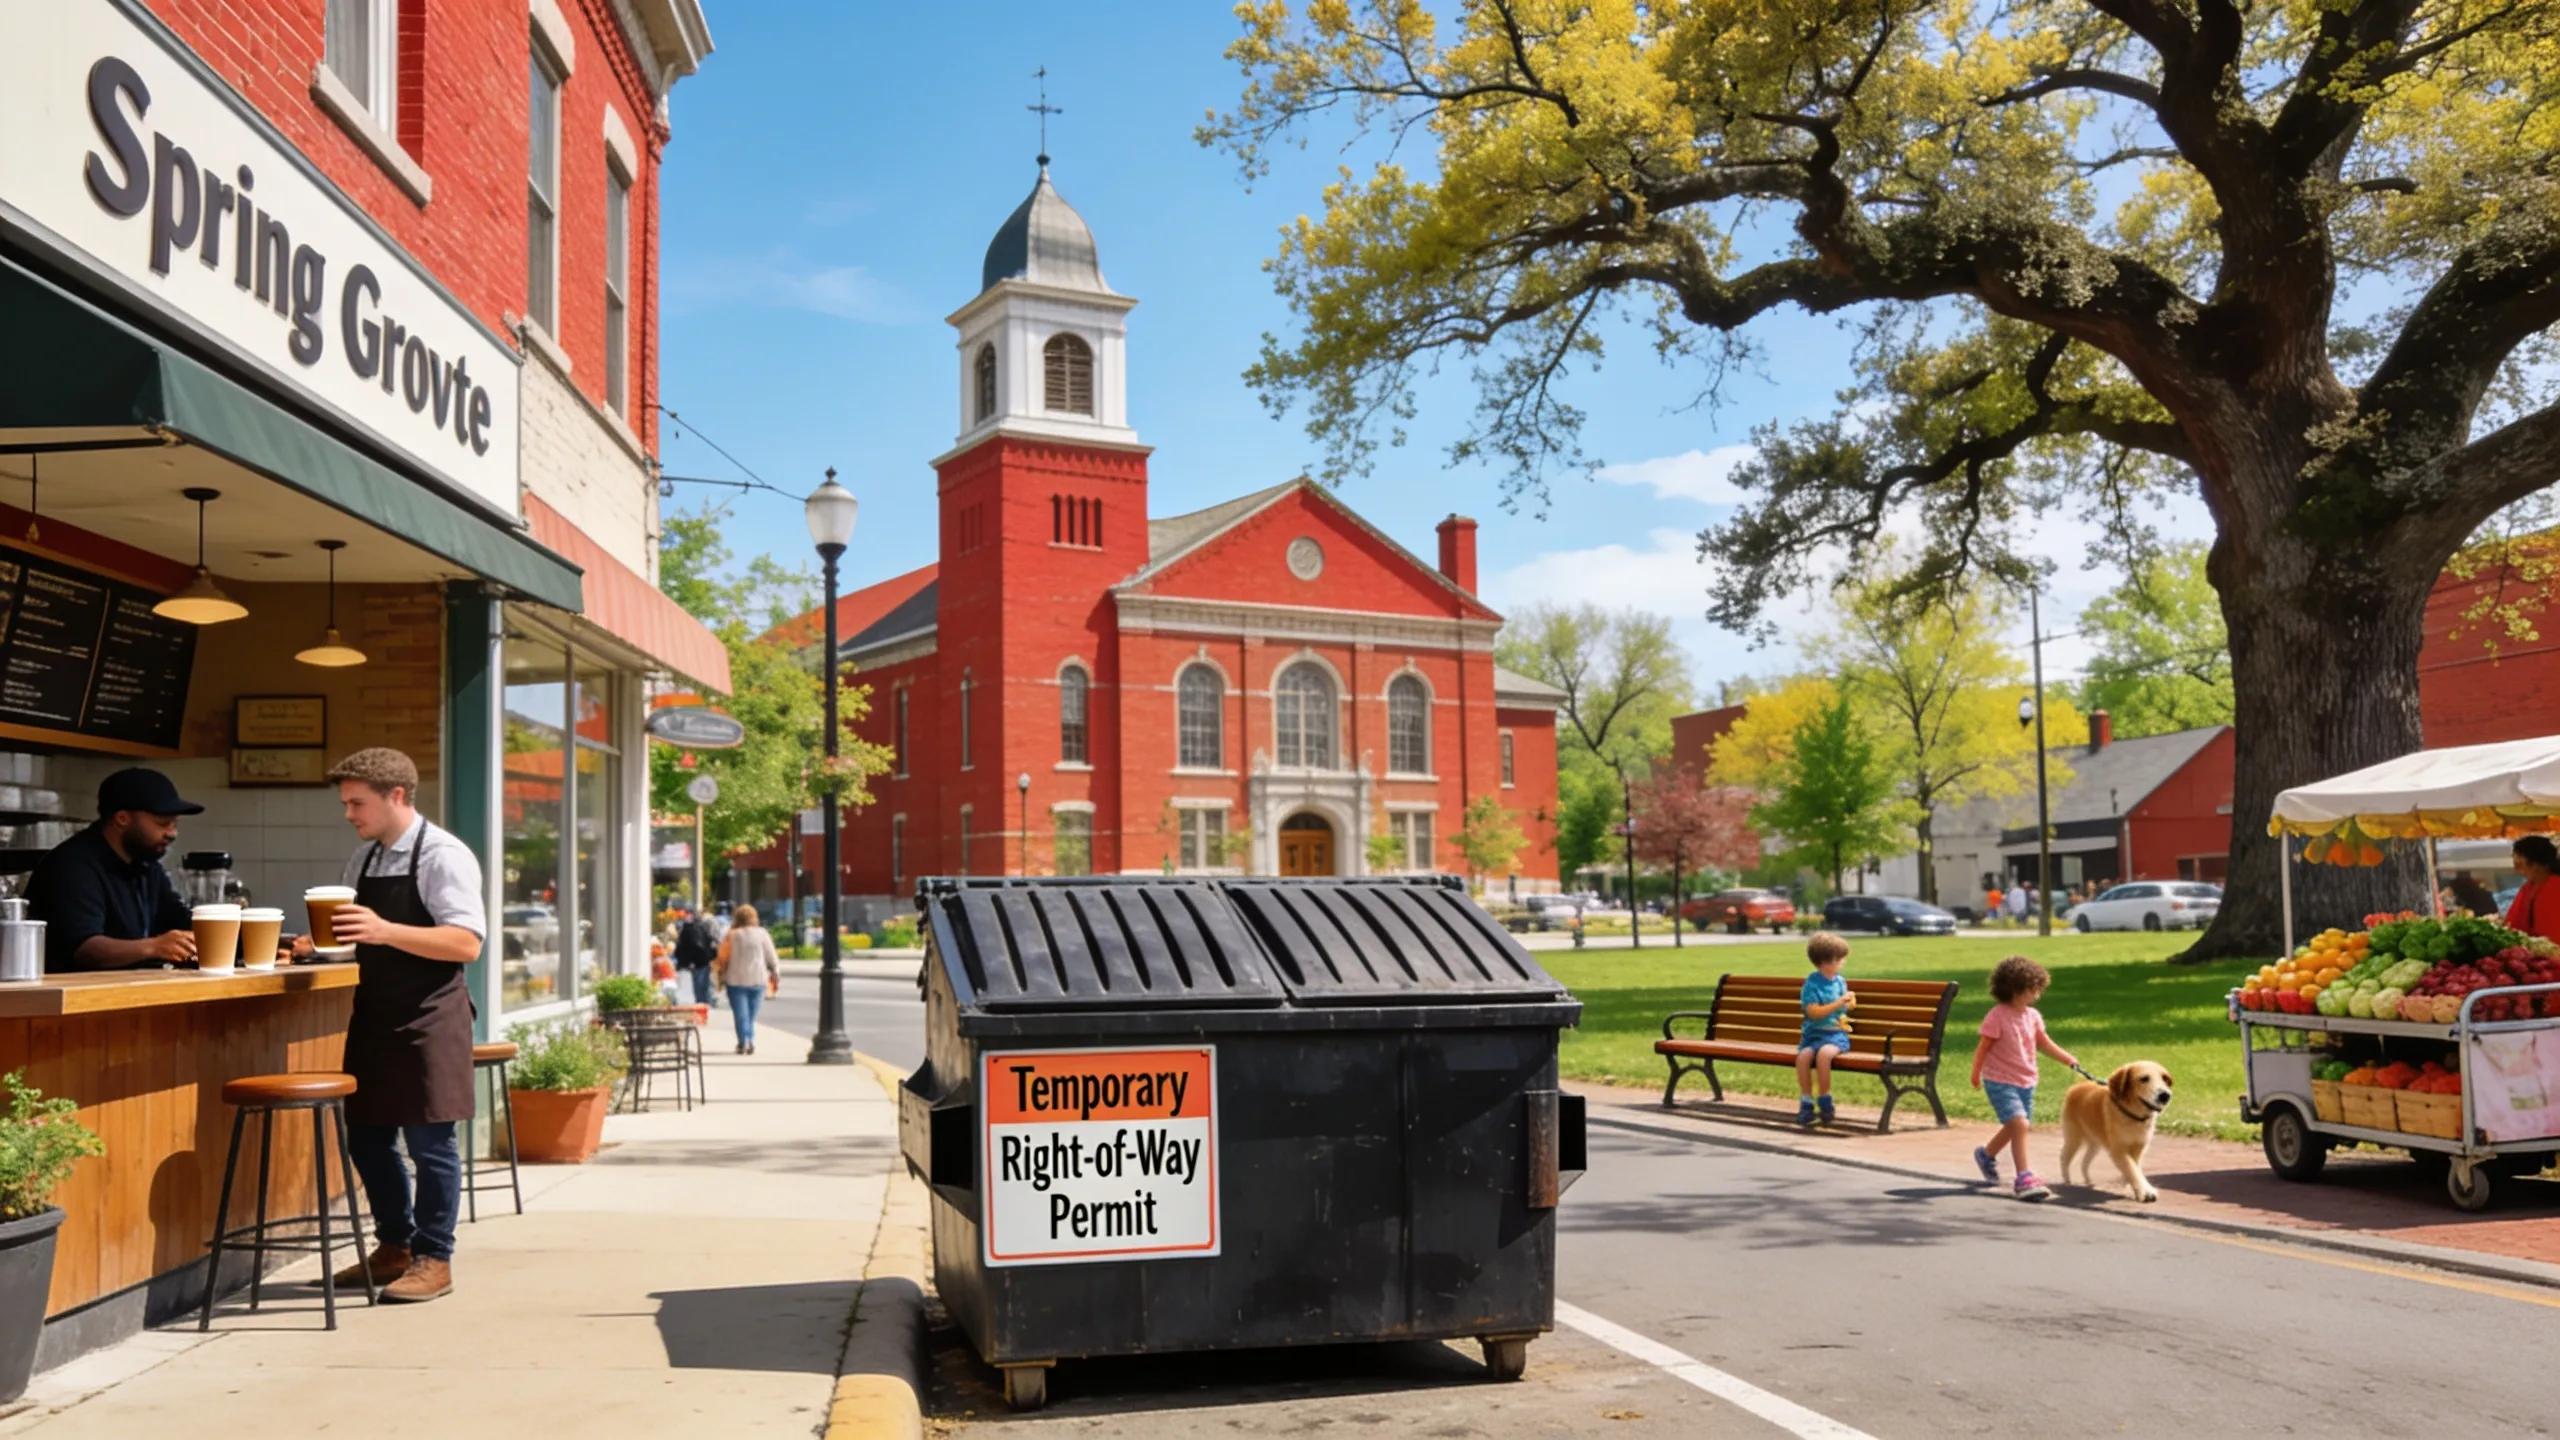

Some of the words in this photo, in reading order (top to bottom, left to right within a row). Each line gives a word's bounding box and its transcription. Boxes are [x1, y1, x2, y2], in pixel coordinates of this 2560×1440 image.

[83, 56, 326, 366] Spring
[341, 264, 492, 456] Grovte
[1009, 1065, 1189, 1121] Temporary
[1001, 1129, 1201, 1192] Right-of-Way
[1050, 1189, 1158, 1239] Permit
